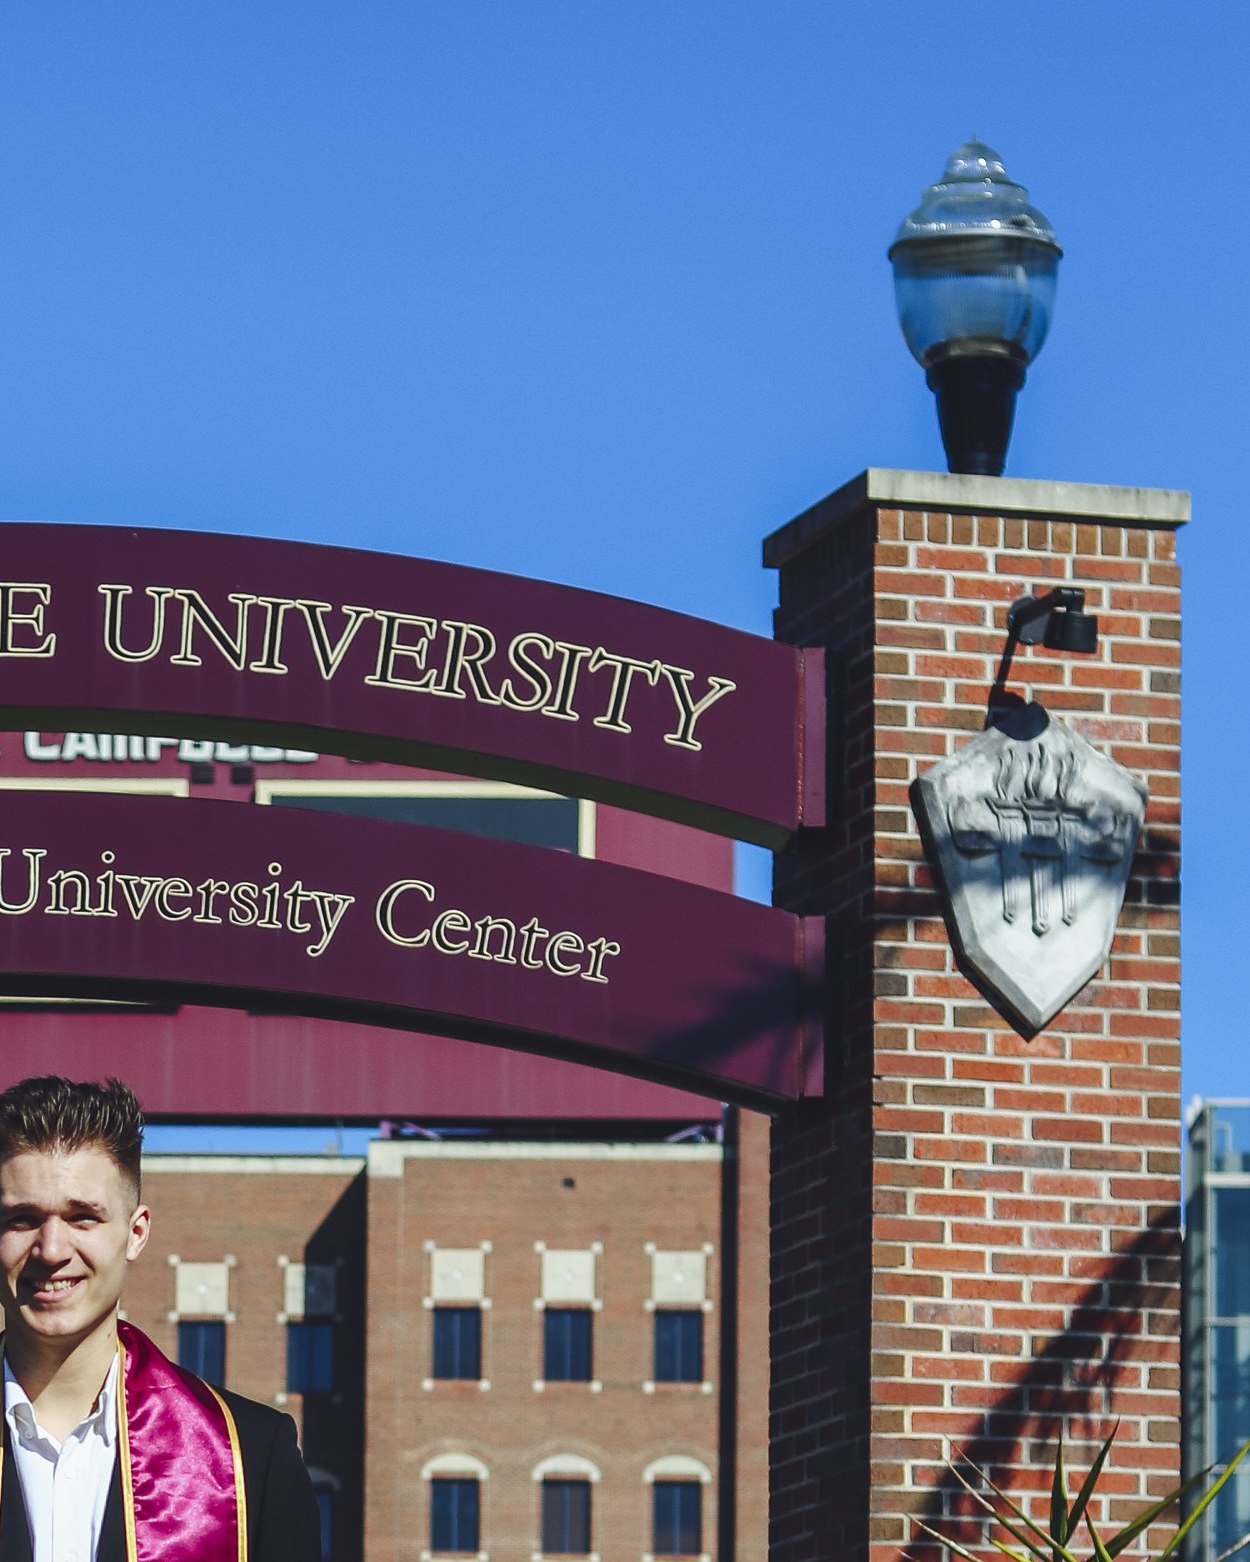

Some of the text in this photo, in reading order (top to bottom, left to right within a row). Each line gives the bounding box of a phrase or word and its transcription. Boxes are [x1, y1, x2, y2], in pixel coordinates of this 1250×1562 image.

[97, 583, 737, 752] UNIVERSITY
[24, 731, 319, 763] CAMP
[375, 879, 621, 984] Center
